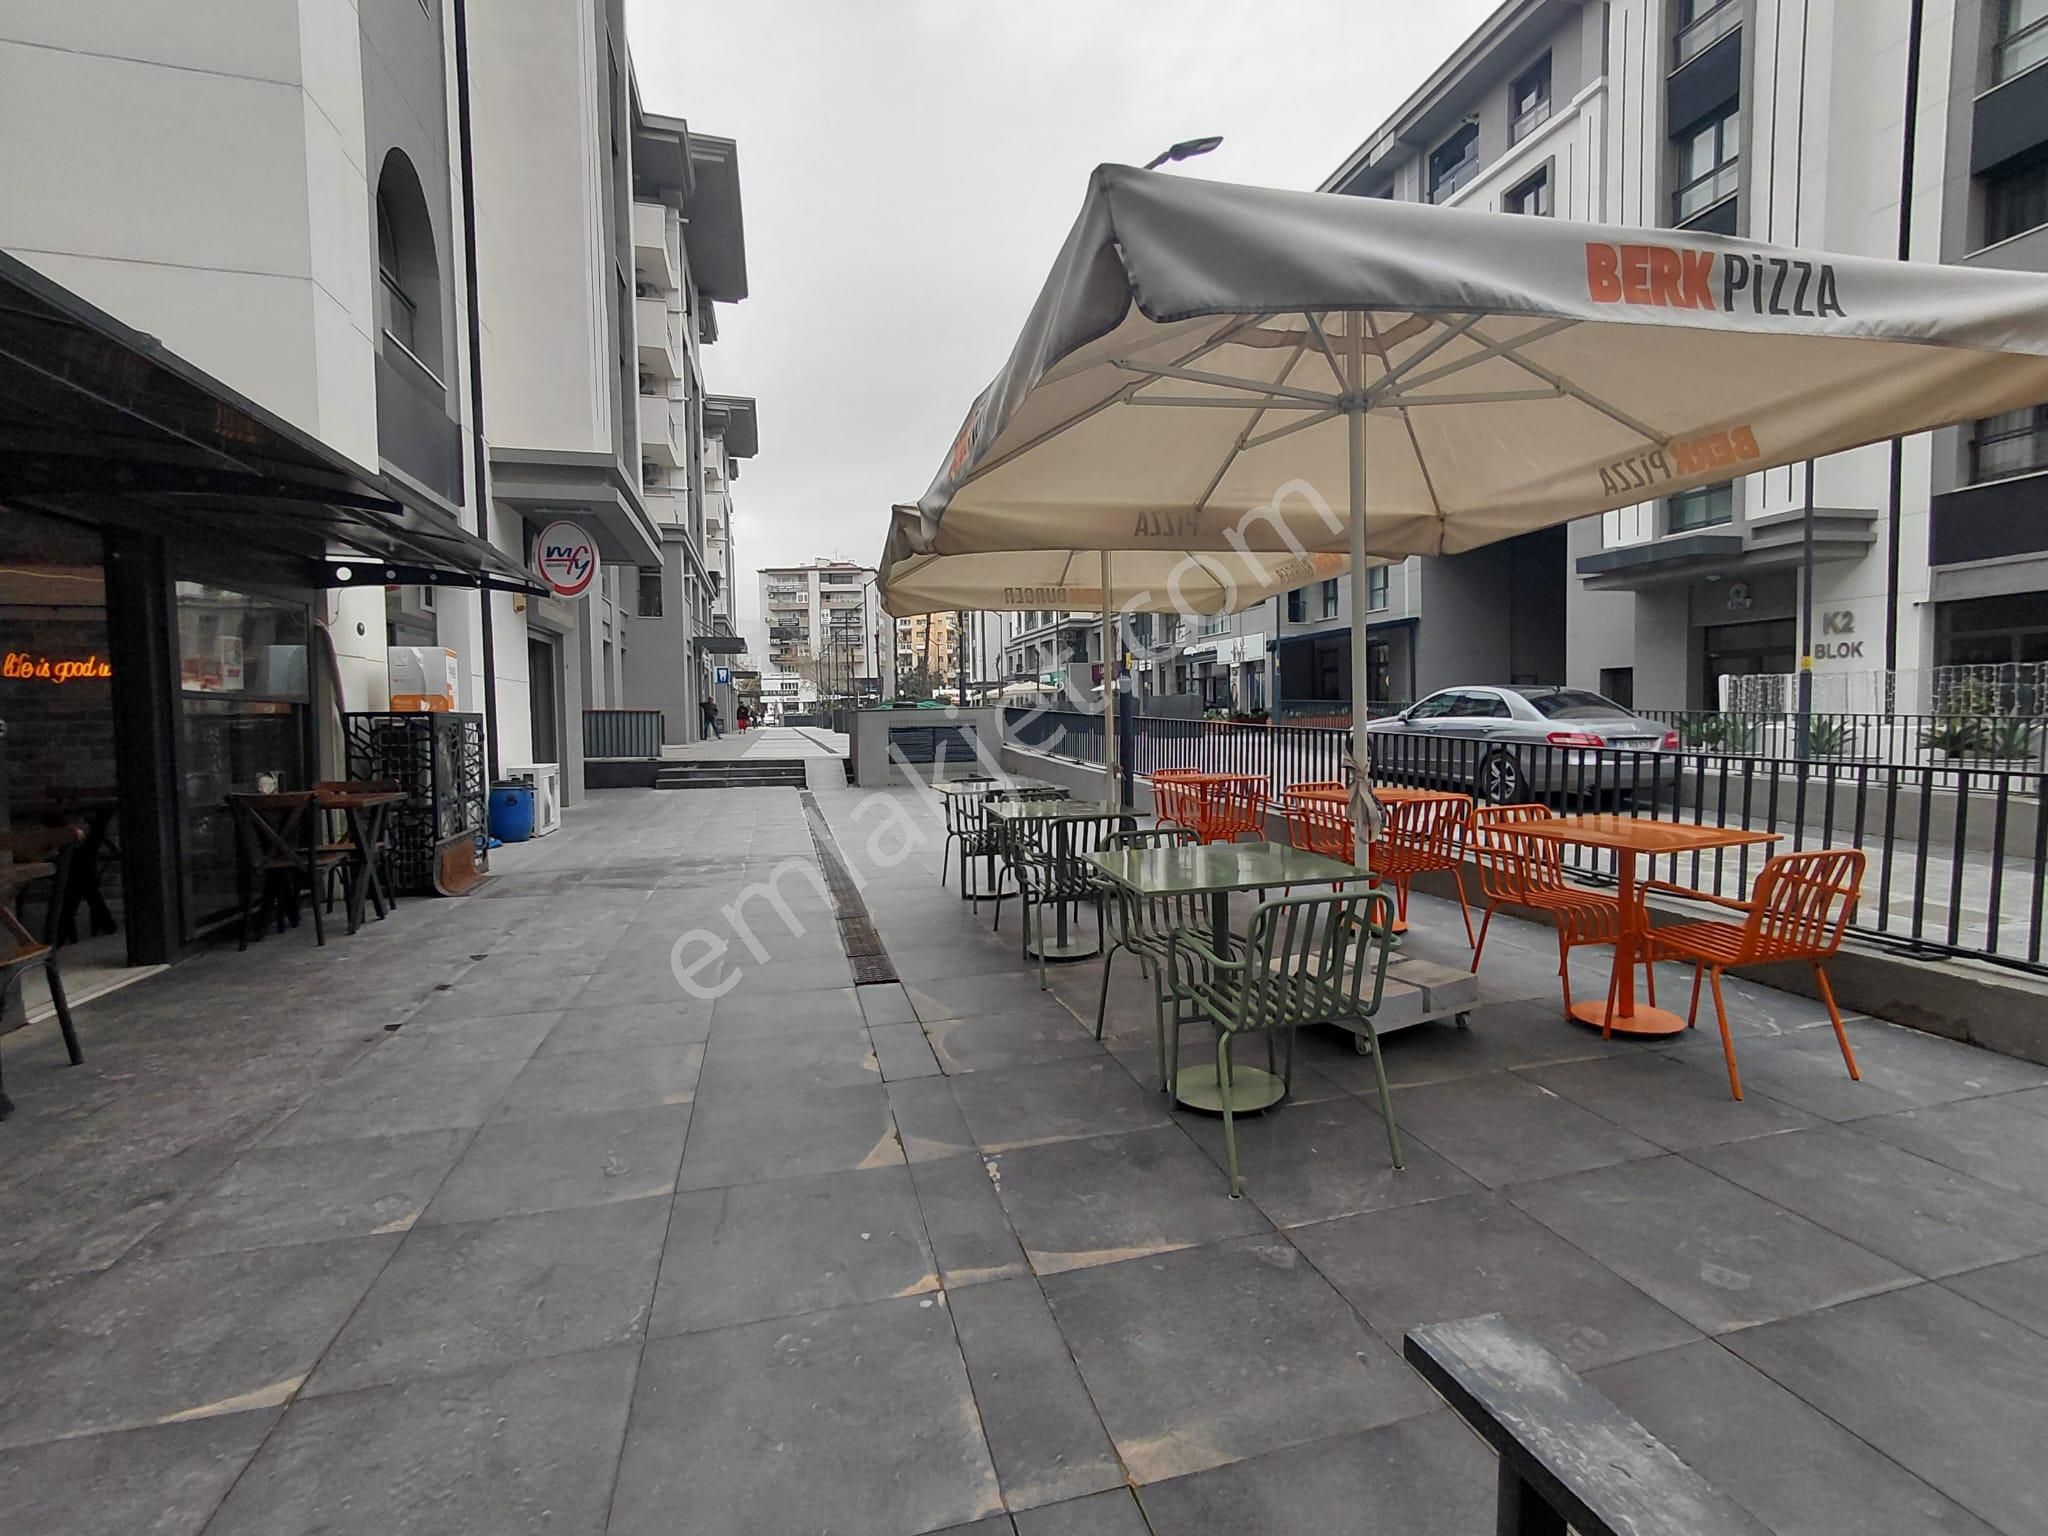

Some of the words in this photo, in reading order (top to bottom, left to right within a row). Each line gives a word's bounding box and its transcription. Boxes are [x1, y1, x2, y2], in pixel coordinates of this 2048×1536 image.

[1585, 242, 1716, 310] BERK
[1823, 610, 1855, 635] K2
[1814, 641, 1864, 660] BLOK
[4, 653, 34, 678] life
[36, 658, 50, 677] is
[52, 655, 97, 684] good
